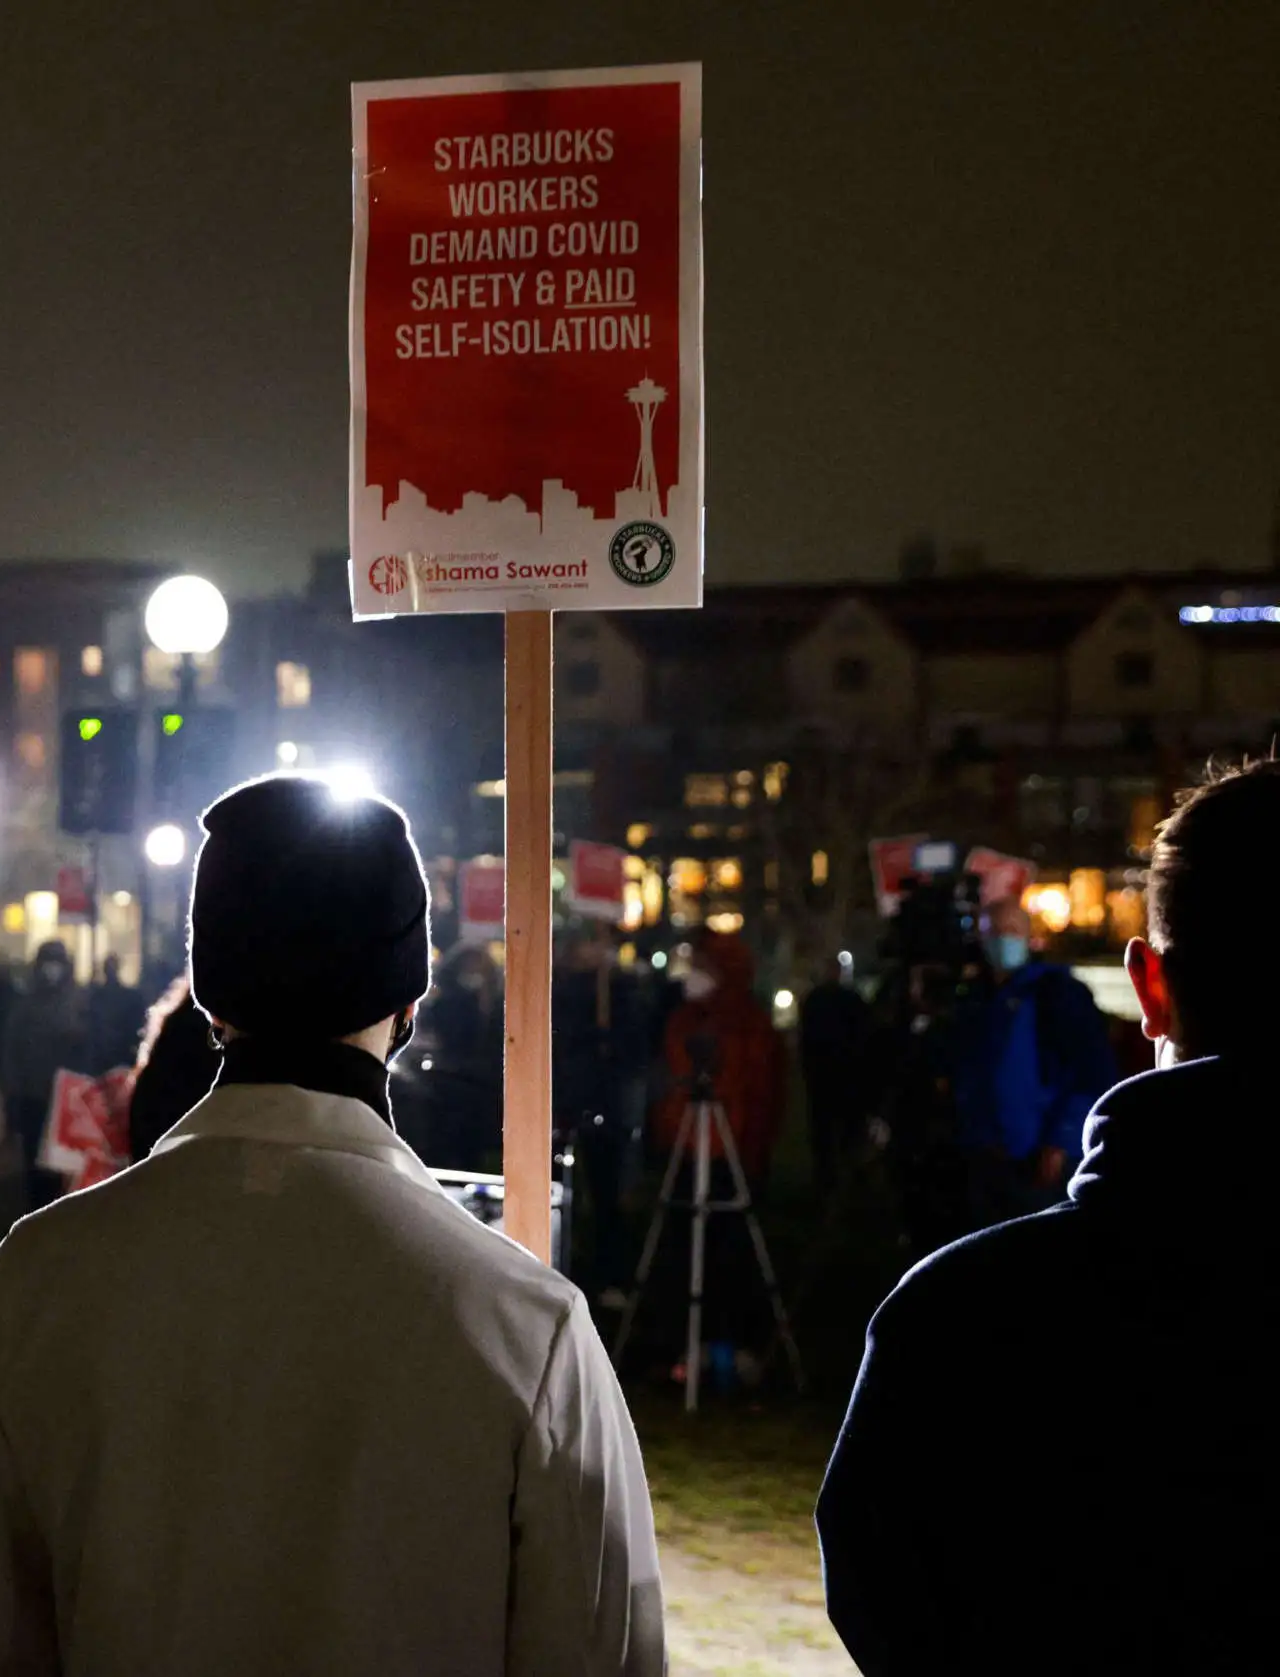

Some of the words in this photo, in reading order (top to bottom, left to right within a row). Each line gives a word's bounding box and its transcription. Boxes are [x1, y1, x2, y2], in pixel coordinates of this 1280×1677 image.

[434, 128, 614, 171] STARBUCKS
[448, 175, 599, 218] WORKERS
[409, 225, 538, 265] DEMAND
[547, 220, 639, 257] COVID
[411, 272, 526, 311] SAFETY
[535, 270, 556, 306] &
[564, 267, 637, 309] PAID
[395, 314, 652, 359] SELF-ISOLATION!
[505, 559, 588, 578] Sawant
